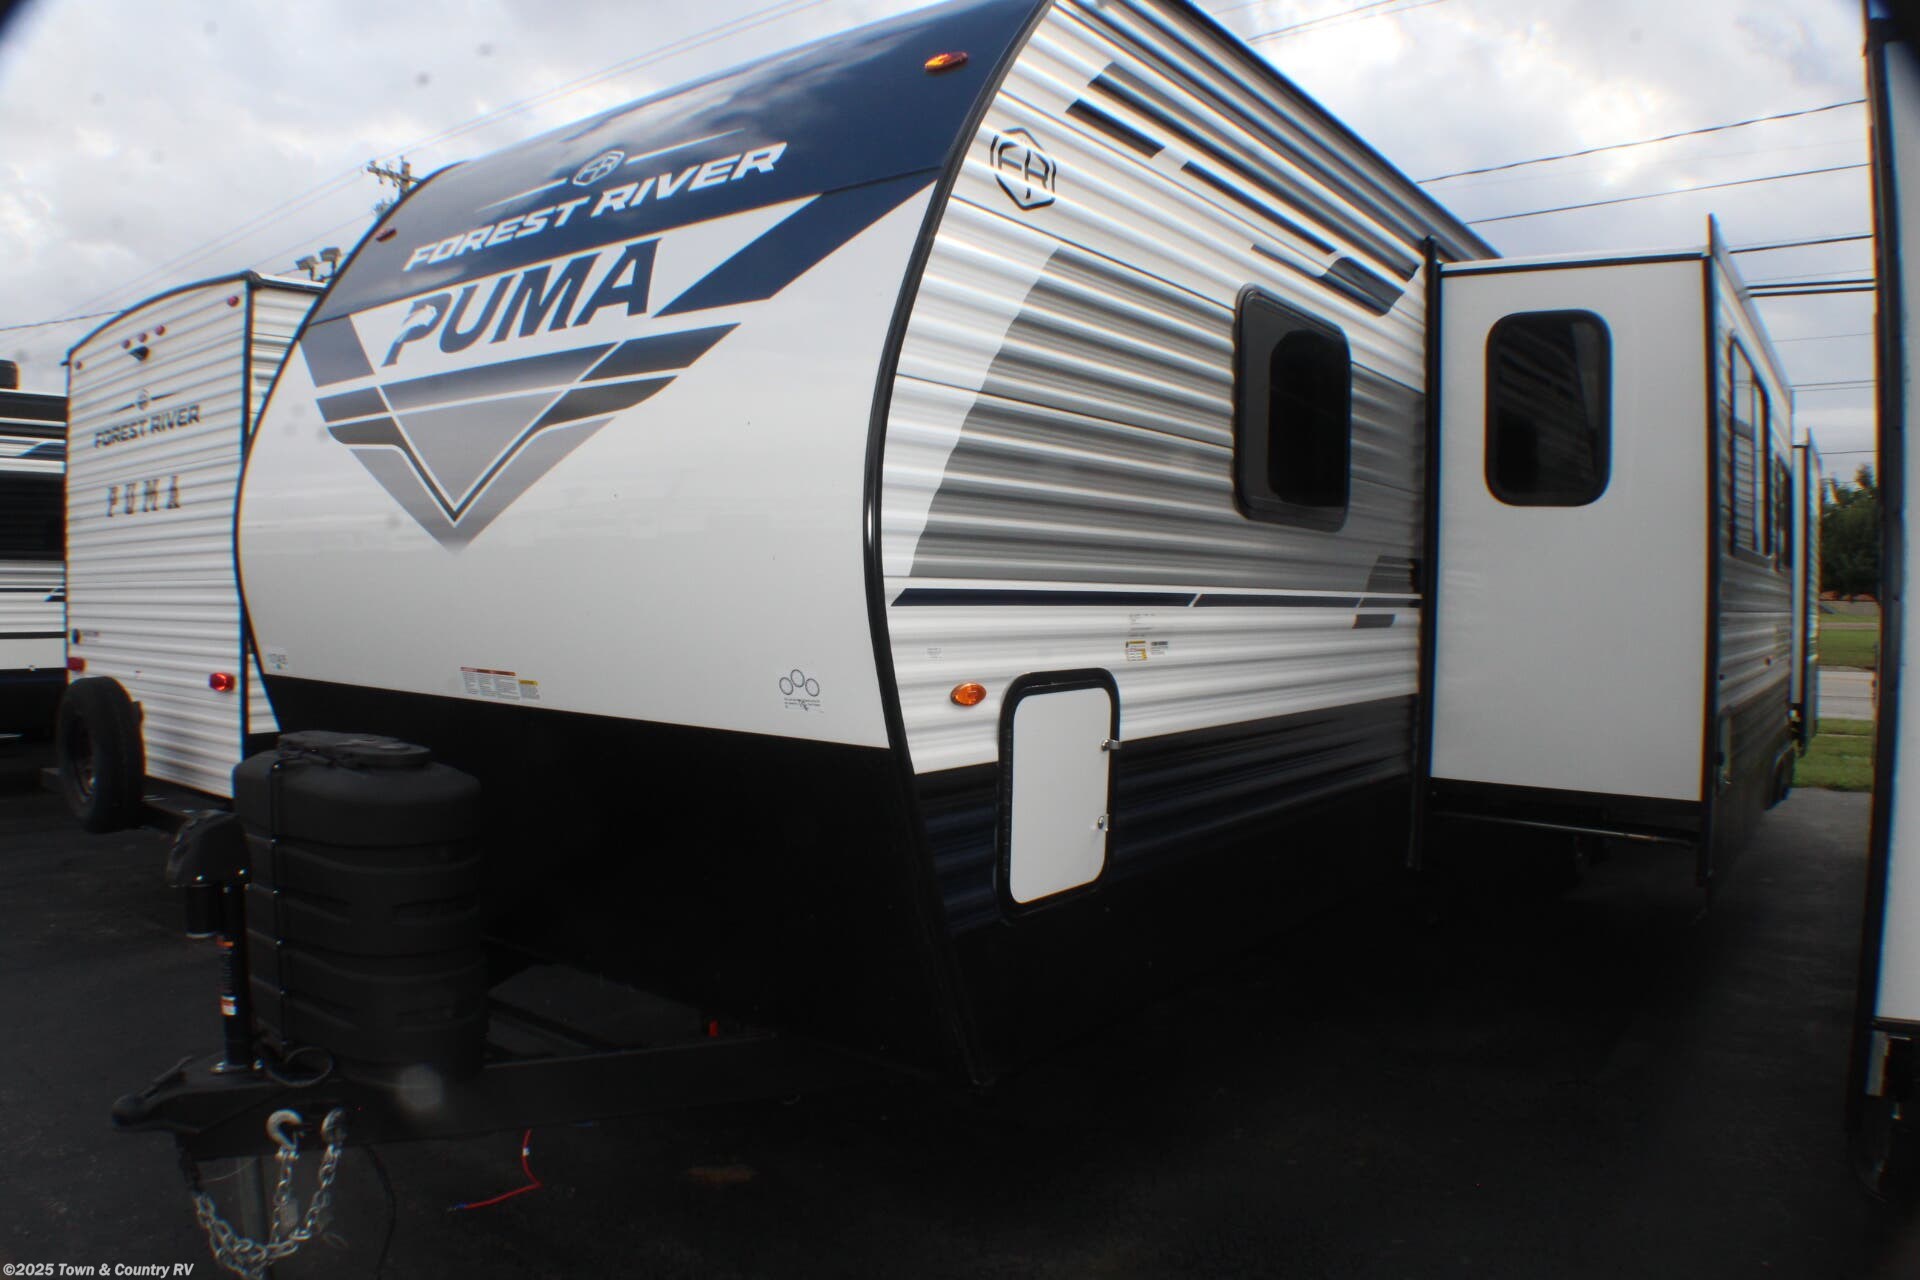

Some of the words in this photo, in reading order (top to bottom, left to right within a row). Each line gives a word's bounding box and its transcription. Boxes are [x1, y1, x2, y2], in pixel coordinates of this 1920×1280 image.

[402, 196, 591, 272] FOREST
[590, 142, 788, 217] RIVER
[381, 237, 663, 367] PUMA
[95, 419, 148, 448] FOREST
[150, 404, 200, 433] RIVER
[106, 475, 180, 517] PUMA
